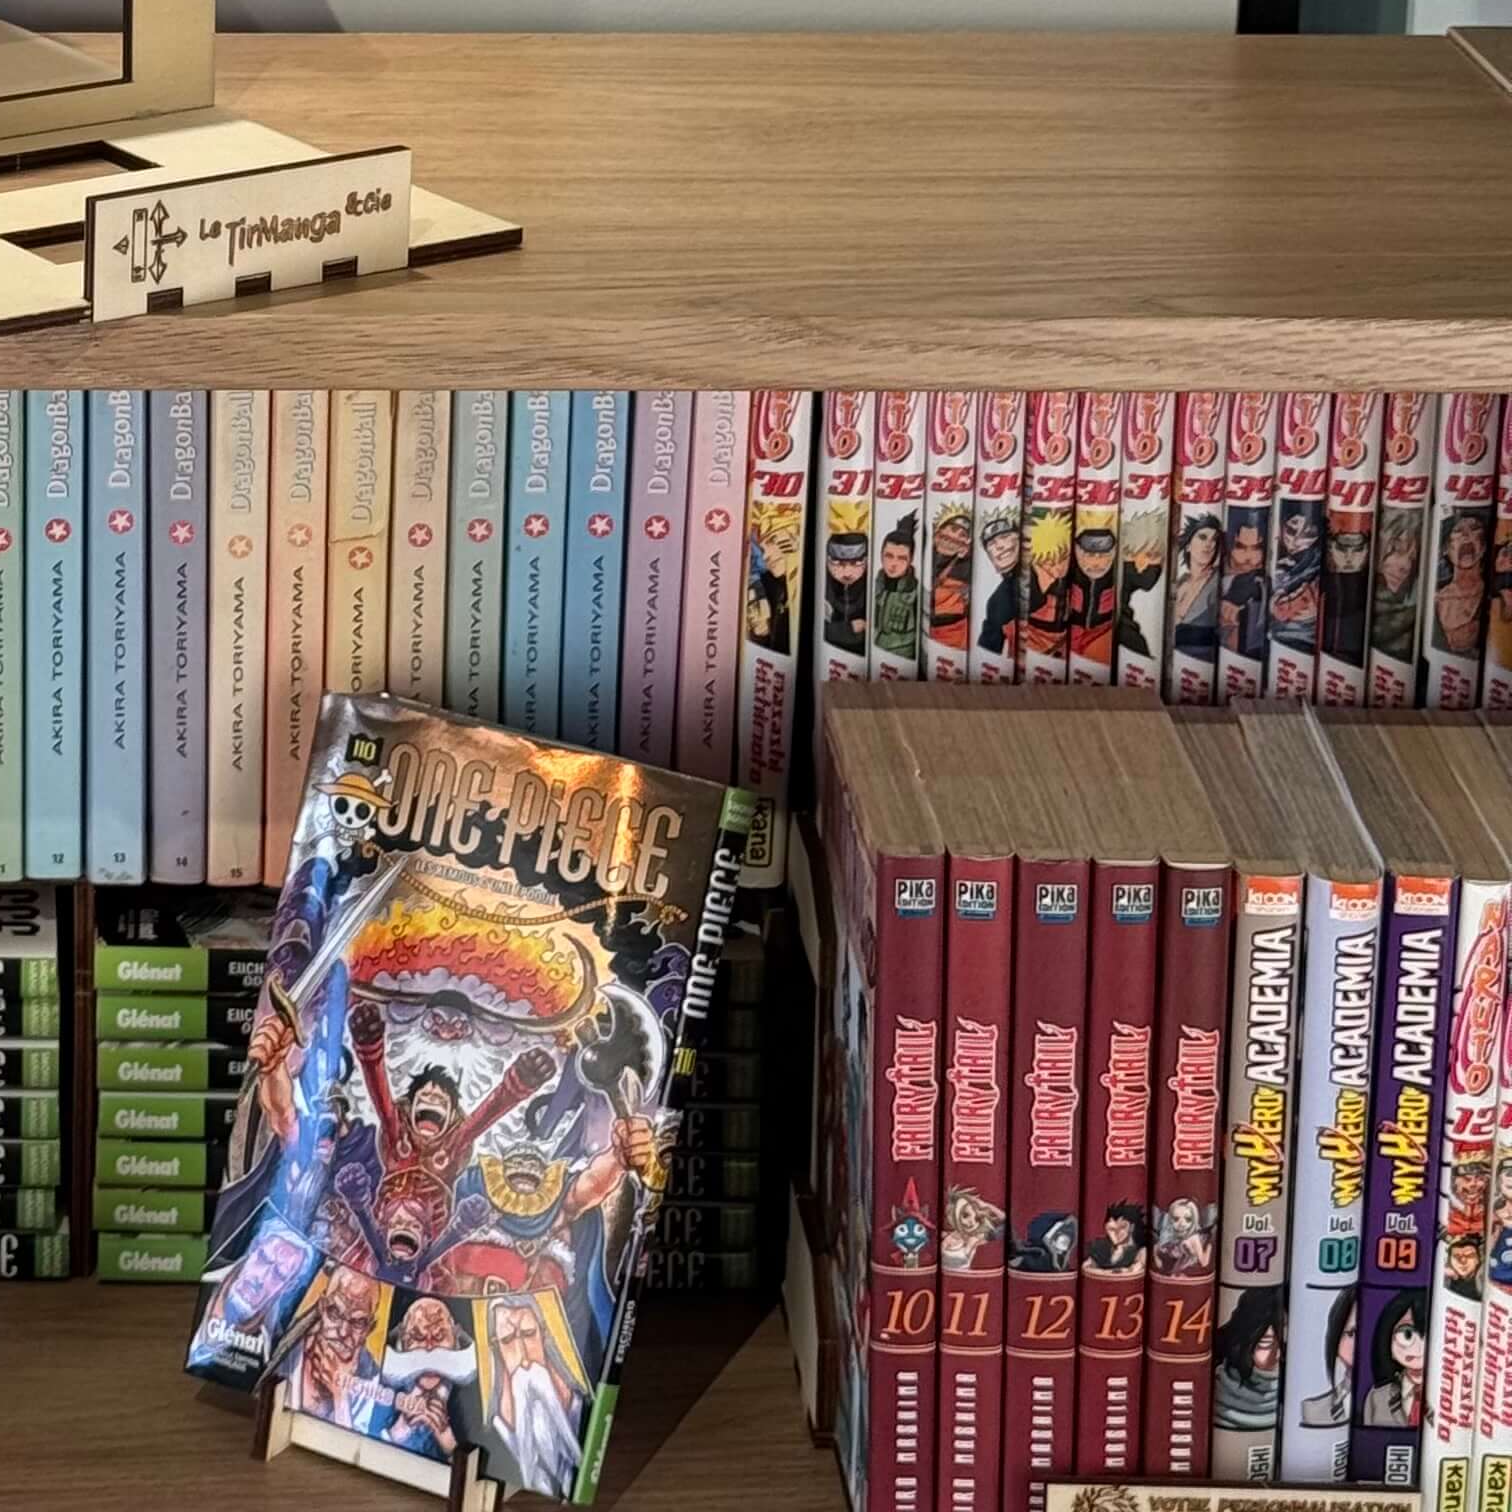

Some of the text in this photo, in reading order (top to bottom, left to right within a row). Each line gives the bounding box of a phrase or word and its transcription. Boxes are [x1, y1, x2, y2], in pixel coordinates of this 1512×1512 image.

[199, 218, 222, 241] Le
[225, 209, 341, 267] TirManga
[46, 390, 72, 498] DragonBa
[108, 390, 135, 488] DragonB
[169, 390, 196, 501] DragonBa
[525, 390, 551, 493] DragonB
[590, 390, 616, 493] DragonB
[647, 390, 676, 495] DragonBa
[52, 559, 63, 756] AKIRA TORIYAMA
[114, 551, 126, 750] AKIRA TORIYAMA
[176, 562, 188, 758] AKIRA TORIYAMA
[232, 576, 245, 772] AKIRA TORIYAMA
[639, 557, 660, 752] AKIRA TORIYAMA
[702, 551, 721, 750] AKIRA TORIYAMA
[352, 739, 376, 760] 110
[117, 960, 182, 982] Glénat
[116, 1007, 181, 1029] Glénat
[1246, 923, 1296, 1087] ACADEMIA
[1331, 929, 1376, 1088] ACADEMIA
[1392, 928, 1443, 1087] ACADEMIA
[118, 1061, 183, 1082] Glénat
[114, 1108, 179, 1130] Glénat
[1453, 1106, 1496, 1135] 12
[115, 1154, 180, 1178] Glénat
[1248, 1158, 1284, 1206] MY
[1333, 1158, 1364, 1208] MY
[1391, 1157, 1425, 1205] MY
[113, 1203, 178, 1227] Glénat
[118, 1250, 183, 1273] Glénat
[1234, 1236, 1277, 1273] 07
[1319, 1237, 1358, 1273] 08
[1377, 1237, 1417, 1271] 09
[886, 1289, 936, 1336] 10
[943, 1292, 990, 1337] 11
[1021, 1295, 1075, 1340] 12
[1094, 1293, 1144, 1341] 13
[1160, 1298, 1212, 1345] 14
